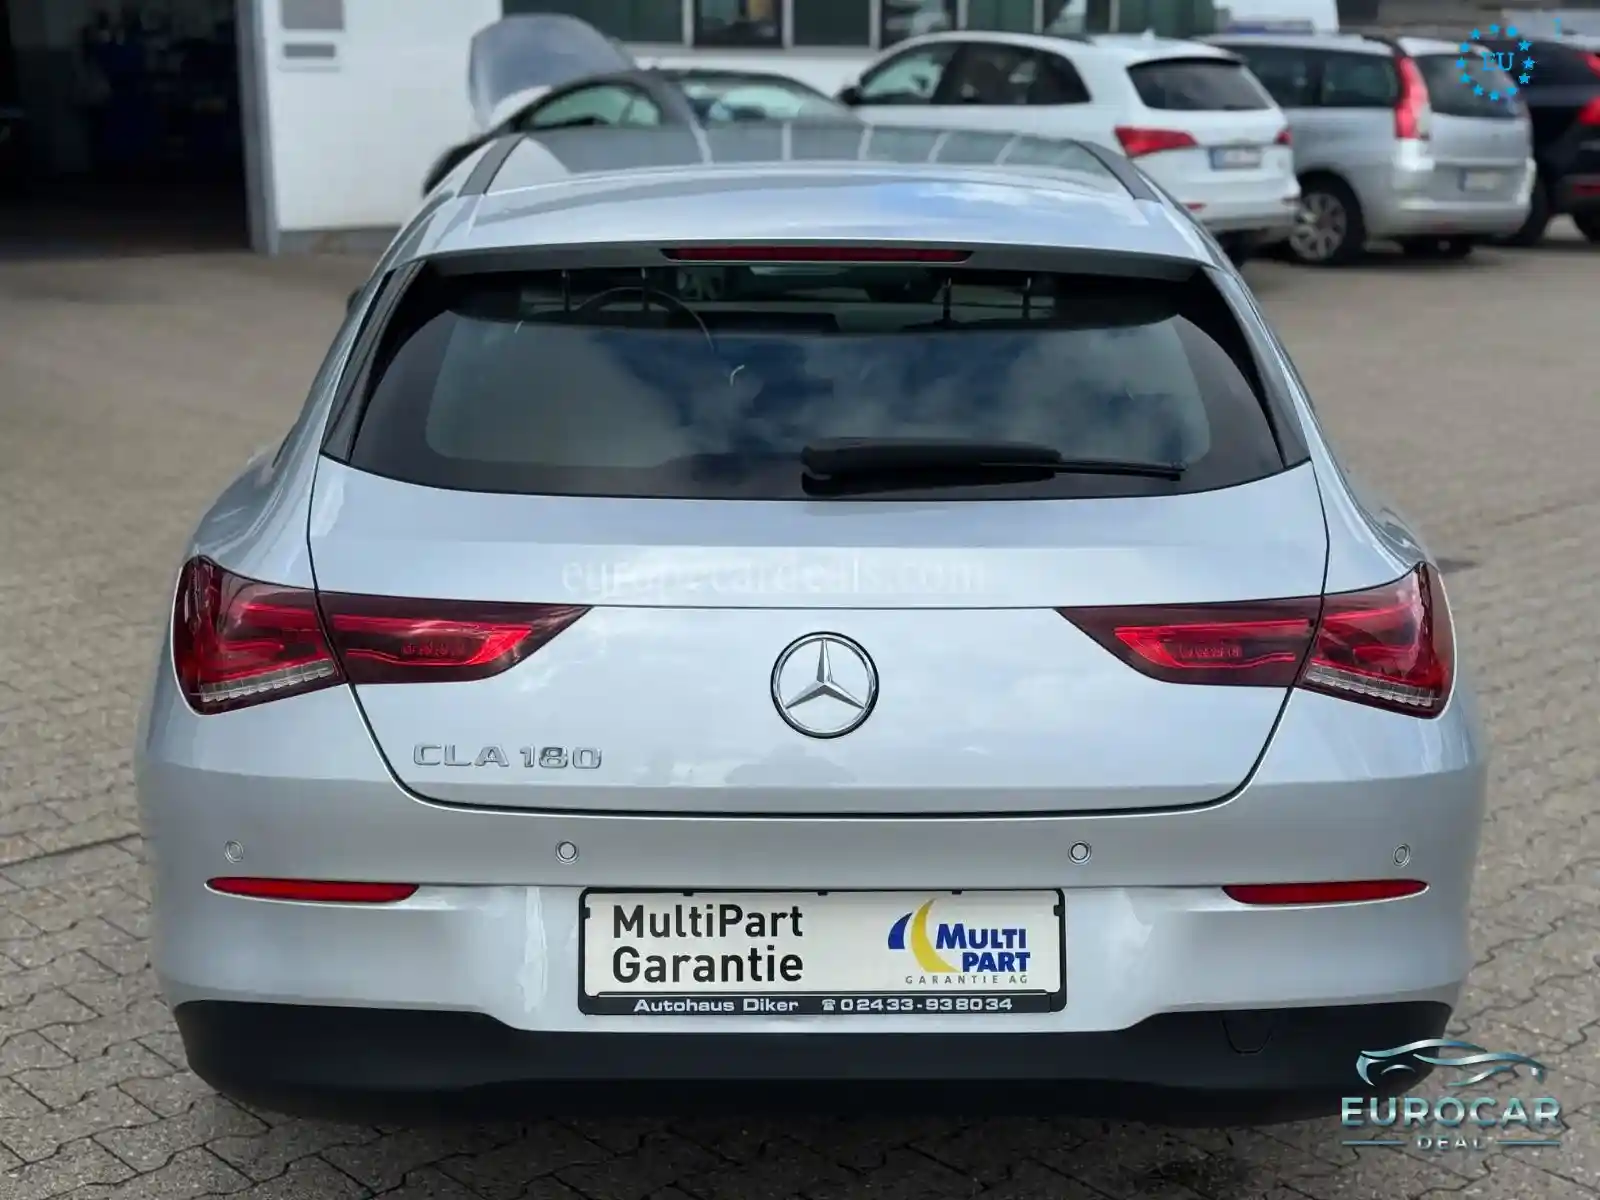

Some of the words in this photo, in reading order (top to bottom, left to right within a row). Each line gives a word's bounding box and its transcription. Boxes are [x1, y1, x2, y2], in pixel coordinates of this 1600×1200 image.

[413, 744, 510, 767] CLA
[519, 744, 602, 769] 180
[613, 904, 803, 938] MultiPart
[936, 923, 1027, 949] MULTI
[612, 944, 803, 983] Garantie
[962, 951, 1031, 973] PART
[905, 974, 999, 985] GARANTIE
[1009, 974, 1028, 984] AG
[633, 999, 735, 1013] Autohaus
[743, 998, 799, 1012] Diker
